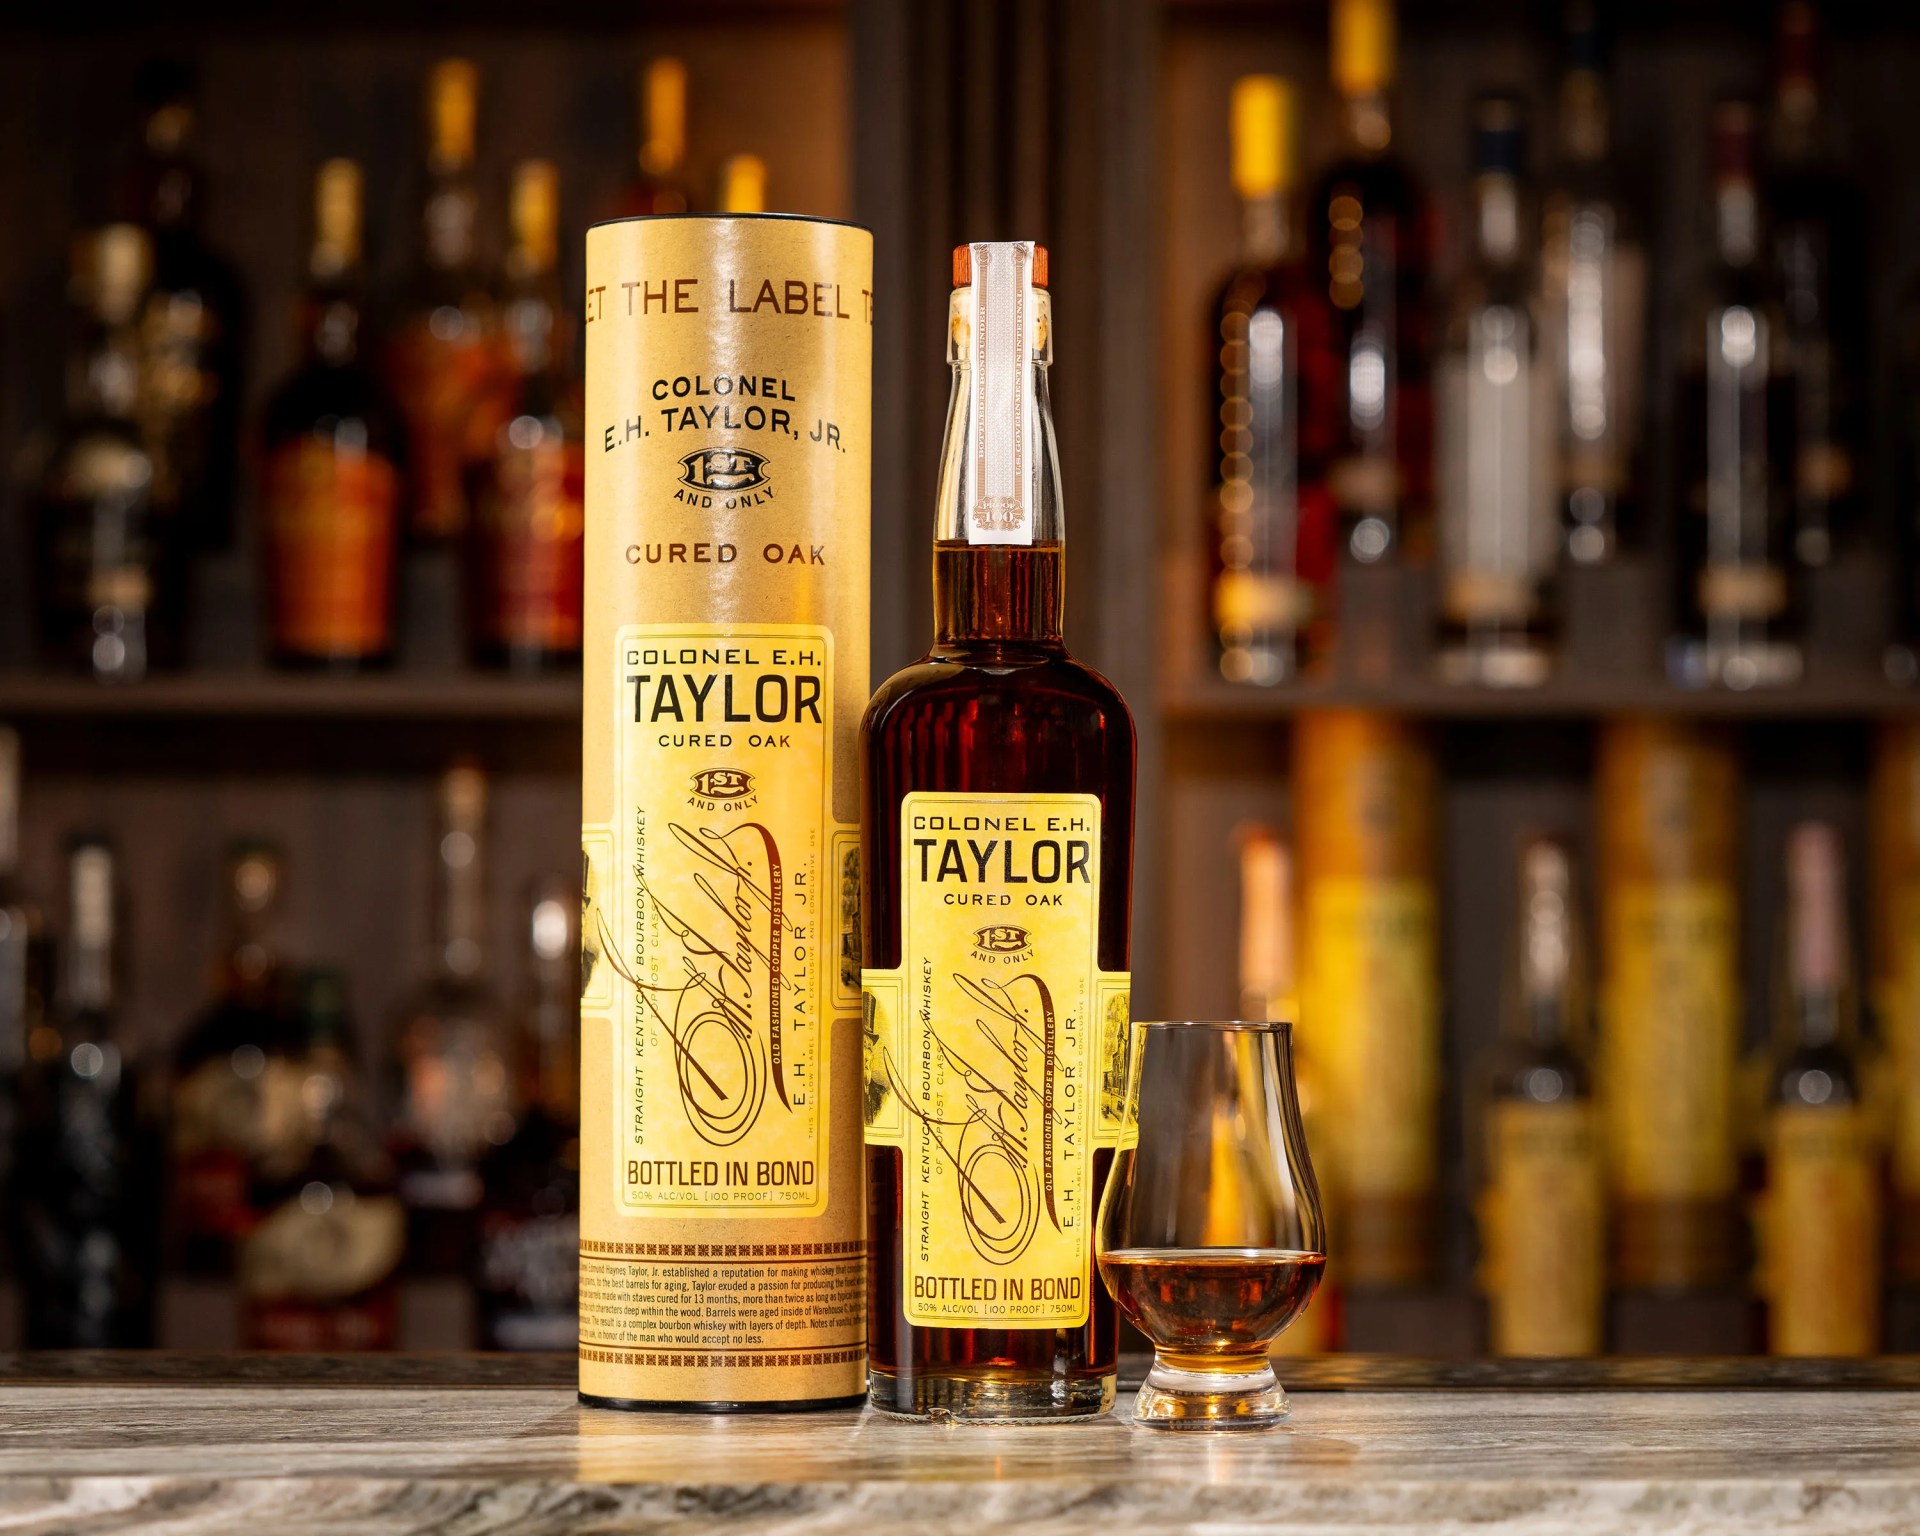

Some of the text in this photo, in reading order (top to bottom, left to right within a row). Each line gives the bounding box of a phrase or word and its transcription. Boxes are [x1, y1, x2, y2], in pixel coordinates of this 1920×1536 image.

[586, 286, 606, 324] ET
[621, 278, 699, 316] THE
[729, 278, 850, 320] LABEL
[1016, 354, 1022, 367] IN
[652, 374, 795, 402] COLONEL
[979, 387, 985, 400] IN
[604, 405, 846, 453] E.H. TAYLOR, JR.
[673, 486, 774, 510] AND ONLY
[985, 511, 1014, 522] 100
[625, 543, 825, 566] CURED OAK
[627, 649, 821, 666] COLONEL E.H.
[627, 674, 822, 724] TAYLOR
[658, 734, 790, 748] CURED OAK
[699, 771, 743, 795] 1ST
[687, 795, 758, 812] AND ONLY
[913, 816, 1091, 832] COLONEL E.H.
[913, 838, 1091, 884] TAYLOR
[943, 893, 1063, 906] CURED OAK
[651, 899, 659, 948] CLASS
[982, 928, 1021, 950] 1ST
[772, 863, 782, 1064] OLD FASHIONED COPPER DISTILLERY
[970, 949, 1035, 964] AND ONLY
[634, 806, 646, 1145] STRAIGHT KENTUCKY BOURBON WHISKEY
[793, 863, 807, 1105] E.H. TAYLOR JR.
[809, 1005, 814, 1015] IN
[809, 1021, 814, 1030] IS
[650, 1028, 658, 1047] OF
[1046, 1010, 1054, 1066] DISTILLERY
[921, 957, 932, 1262] STRAIGHT KENTUCKY BOURBON WHISKEY
[1063, 1009, 1076, 1228] E.H. TAYLOR JR.
[628, 1160, 814, 1186] BOTTLED IN BOND
[936, 1158, 943, 1175] OF
[1045, 1172, 1053, 1191] OLD
[632, 1190, 652, 1200] 50%
[658, 1191, 699, 1201] ALC/VOL
[779, 1190, 810, 1200] 750ML
[651, 1268, 659, 1276] Jr.
[662, 1267, 709, 1278] established
[713, 1269, 718, 1277] a
[721, 1267, 764, 1279] reputation
[767, 1267, 778, 1277] for
[781, 1267, 808, 1278] making
[811, 1265, 834, 1276] whiskey
[626, 1280, 649, 1290] barrels
[651, 1280, 662, 1290] for
[692, 1281, 716, 1292] Taylor
[718, 1281, 748, 1291] exuded
[750, 1282, 755, 1291] a
[758, 1281, 788, 1292] passion
[791, 1280, 801, 1290] for
[803, 1279, 834, 1291] producing
[914, 1275, 1081, 1301] BOTTLED IN BOND
[632, 1294, 655, 1303] staves
[656, 1294, 679, 1304] cured
[681, 1294, 691, 1304] for
[694, 1295, 704, 1304] 13
[743, 1296, 763, 1304] more
[765, 1294, 783, 1304] than
[785, 1294, 805, 1303] twice
[806, 1295, 814, 1303] as
[815, 1293, 828, 1303] long
[624, 1305, 640, 1316] deep
[641, 1307, 664, 1316] within
[666, 1307, 679, 1316] the
[681, 1307, 703, 1317] wood.
[706, 1308, 736, 1317] Barrels
[738, 1309, 758, 1317] were
[760, 1307, 779, 1318] aged
[781, 1307, 803, 1316] inside
[805, 1306, 811, 1315] of
[918, 1303, 937, 1312] 50%
[942, 1304, 979, 1314] ALC/VOL
[1050, 1303, 1077, 1313] 750ML
[616, 1318, 621, 1327] is
[628, 1320, 657, 1330] complex
[659, 1320, 691, 1330] bourbon
[694, 1321, 726, 1332] whiskey
[729, 1321, 746, 1330] with
[749, 1321, 774, 1332] layers
[775, 1320, 783, 1330] of
[810, 1318, 828, 1329] Notes
[829, 1318, 835, 1328] of
[619, 1331, 625, 1341] of
[627, 1331, 637, 1341] the
[639, 1334, 655, 1342] man
[657, 1333, 673, 1342] who
[675, 1333, 699, 1343] would
[702, 1334, 729, 1345] accept
[732, 1336, 743, 1344] no
[745, 1334, 764, 1344] less.
